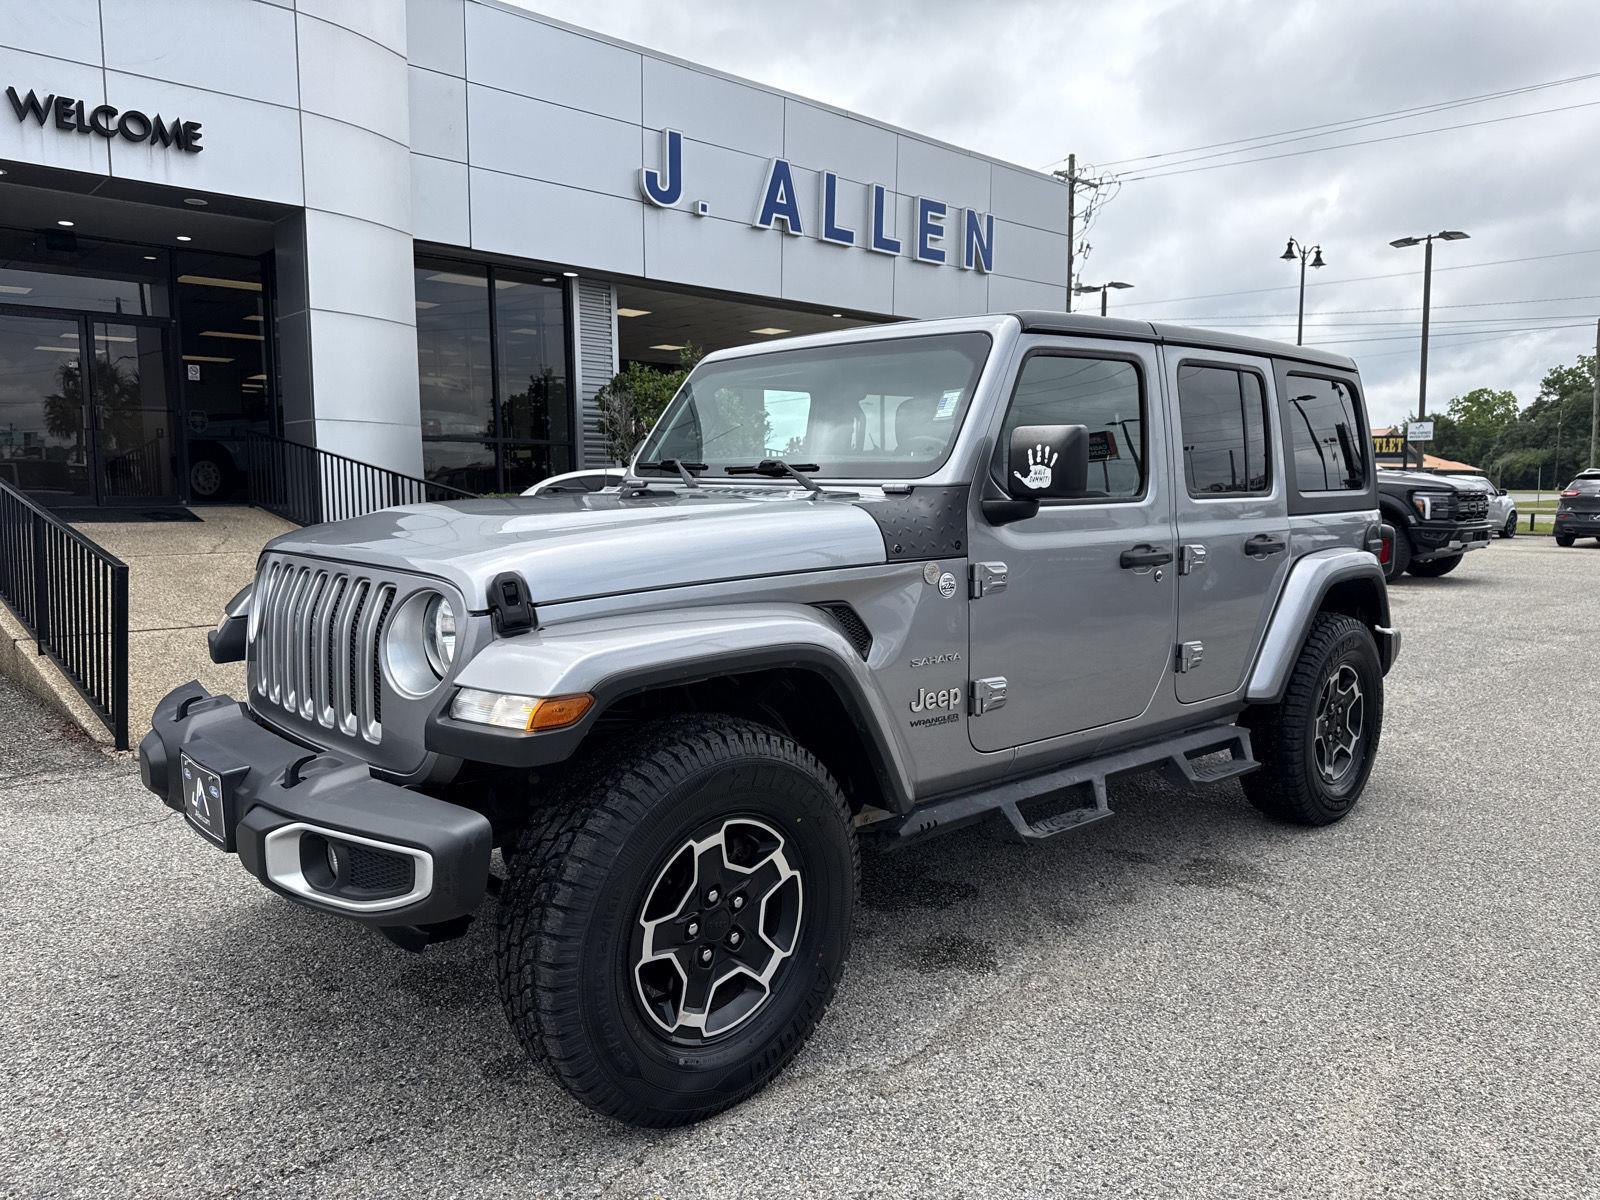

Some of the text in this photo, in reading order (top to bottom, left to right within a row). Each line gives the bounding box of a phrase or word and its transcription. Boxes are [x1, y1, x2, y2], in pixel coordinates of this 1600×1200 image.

[6, 86, 204, 153] WELCOME
[638, 127, 995, 274] J. ALLEN
[1372, 437, 1404, 453] TLET
[910, 652, 962, 668] SAHARA
[909, 687, 962, 713] Jeep
[909, 713, 959, 727] WRANGLER
